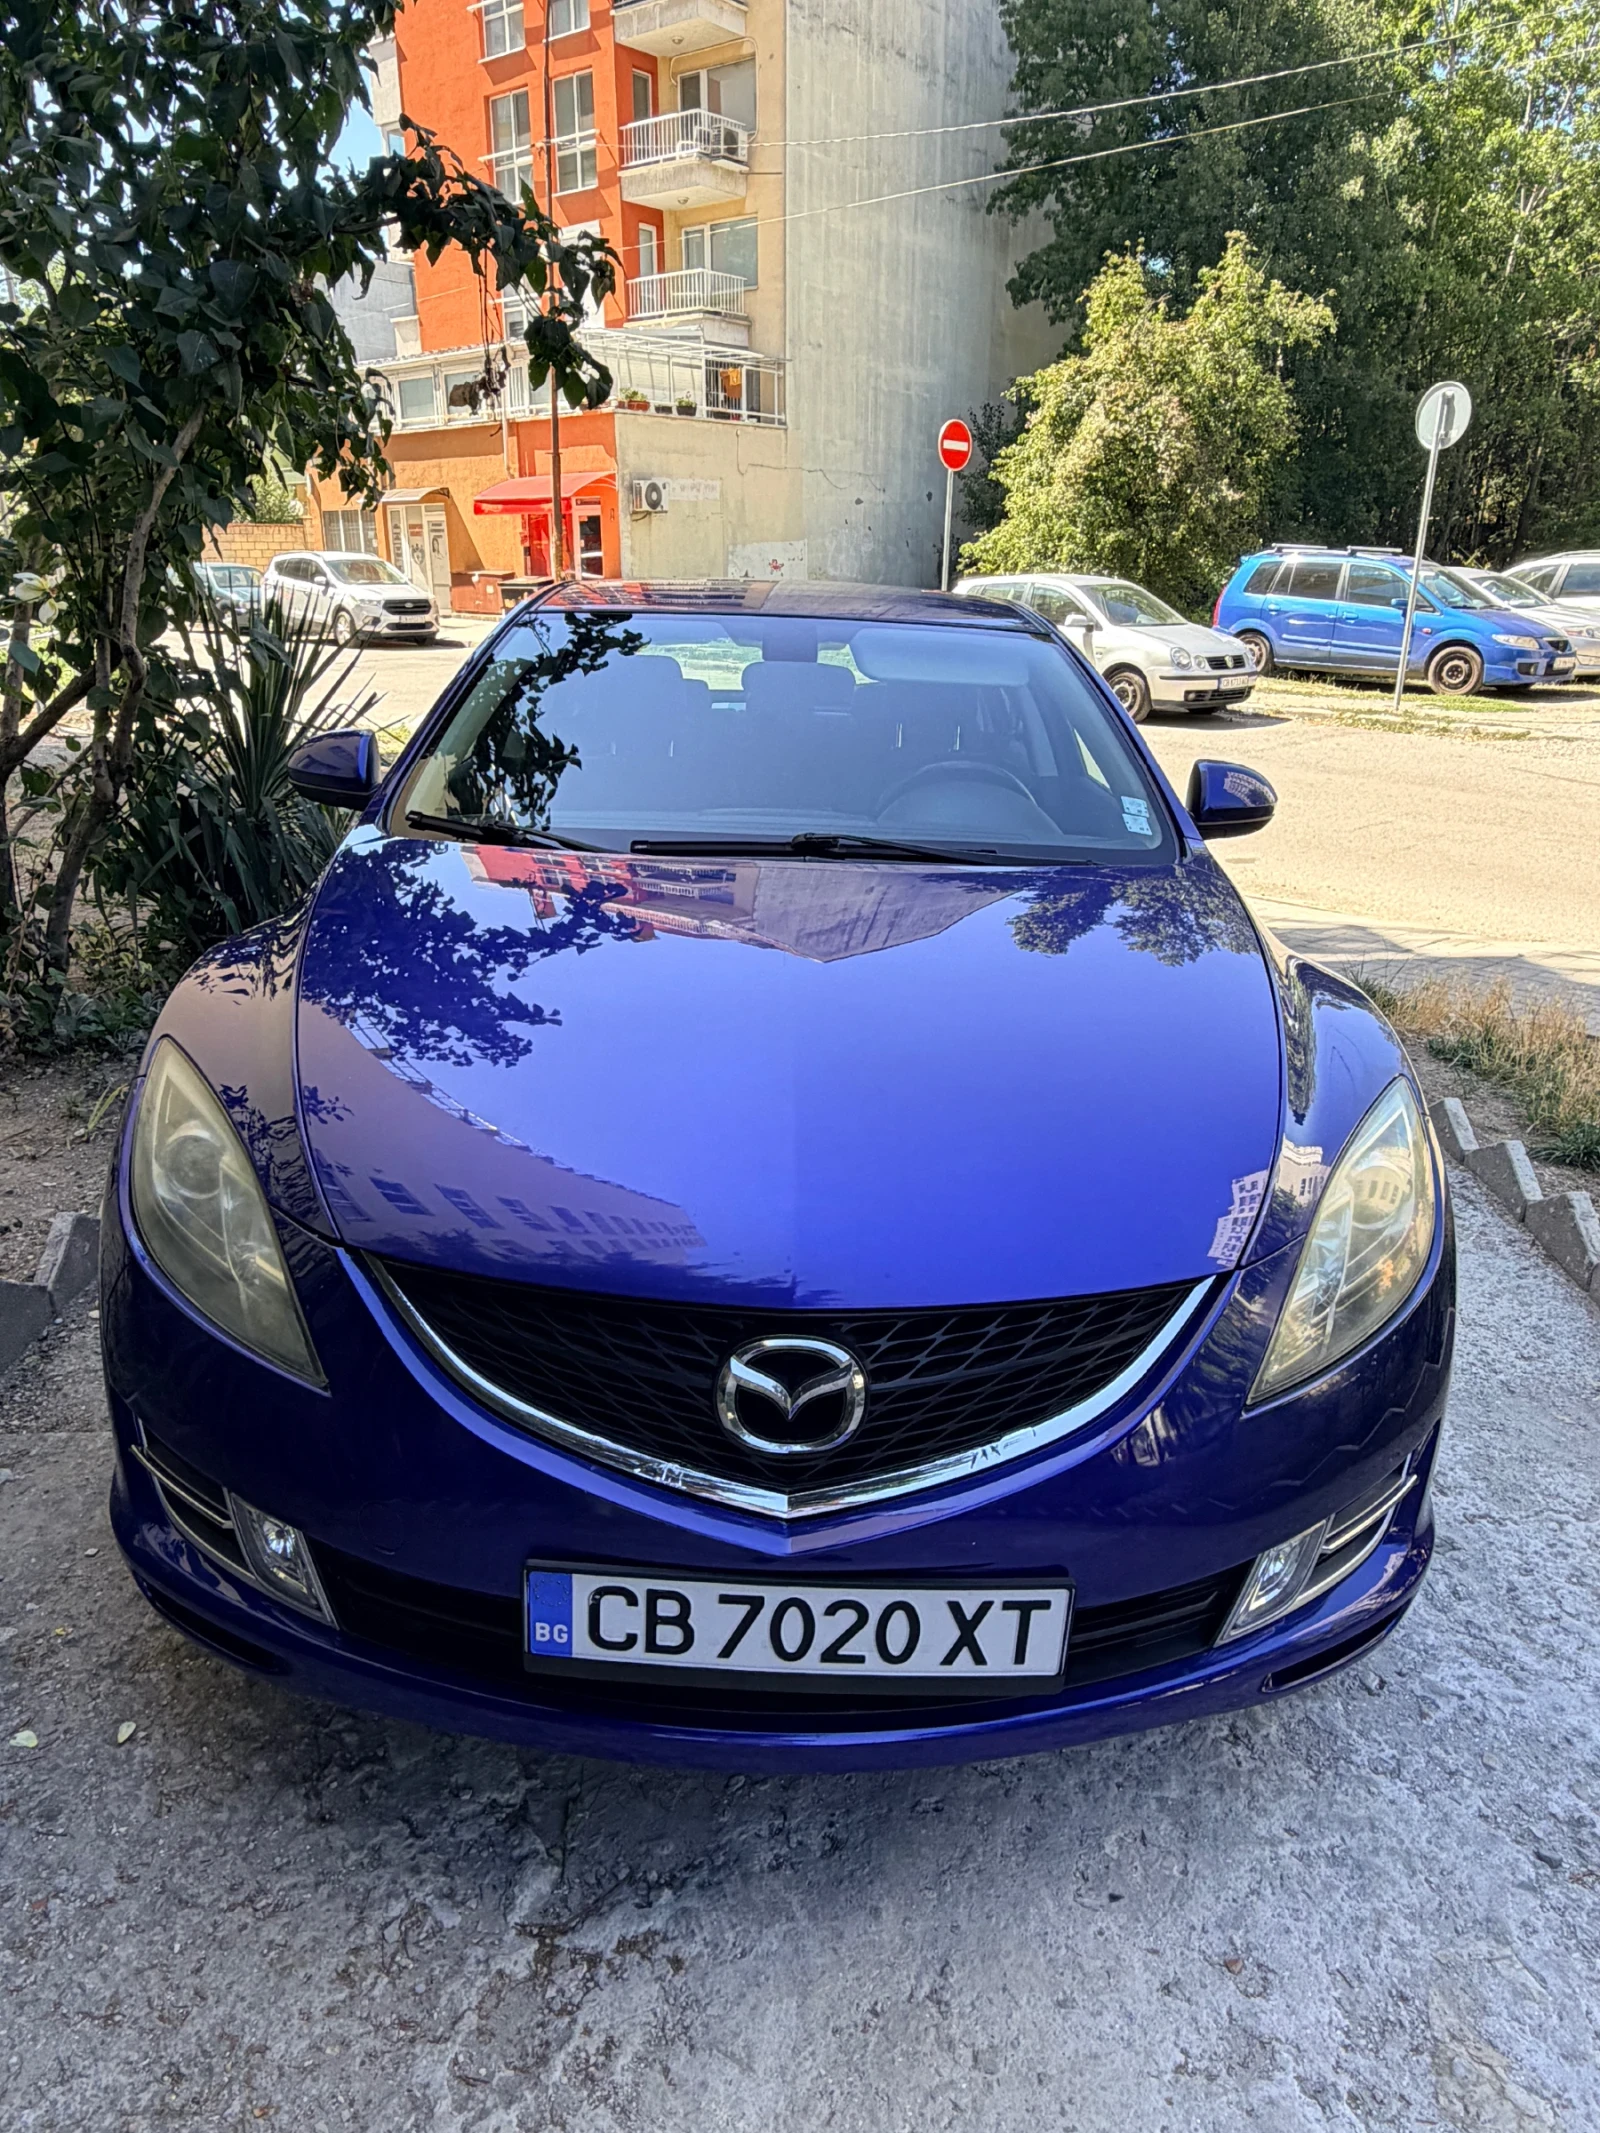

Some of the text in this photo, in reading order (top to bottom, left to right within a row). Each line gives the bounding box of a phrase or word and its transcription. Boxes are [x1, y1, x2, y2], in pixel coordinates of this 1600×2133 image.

[535, 1621, 568, 1643] BG
[587, 1585, 1052, 1666] CB 7020 XT
